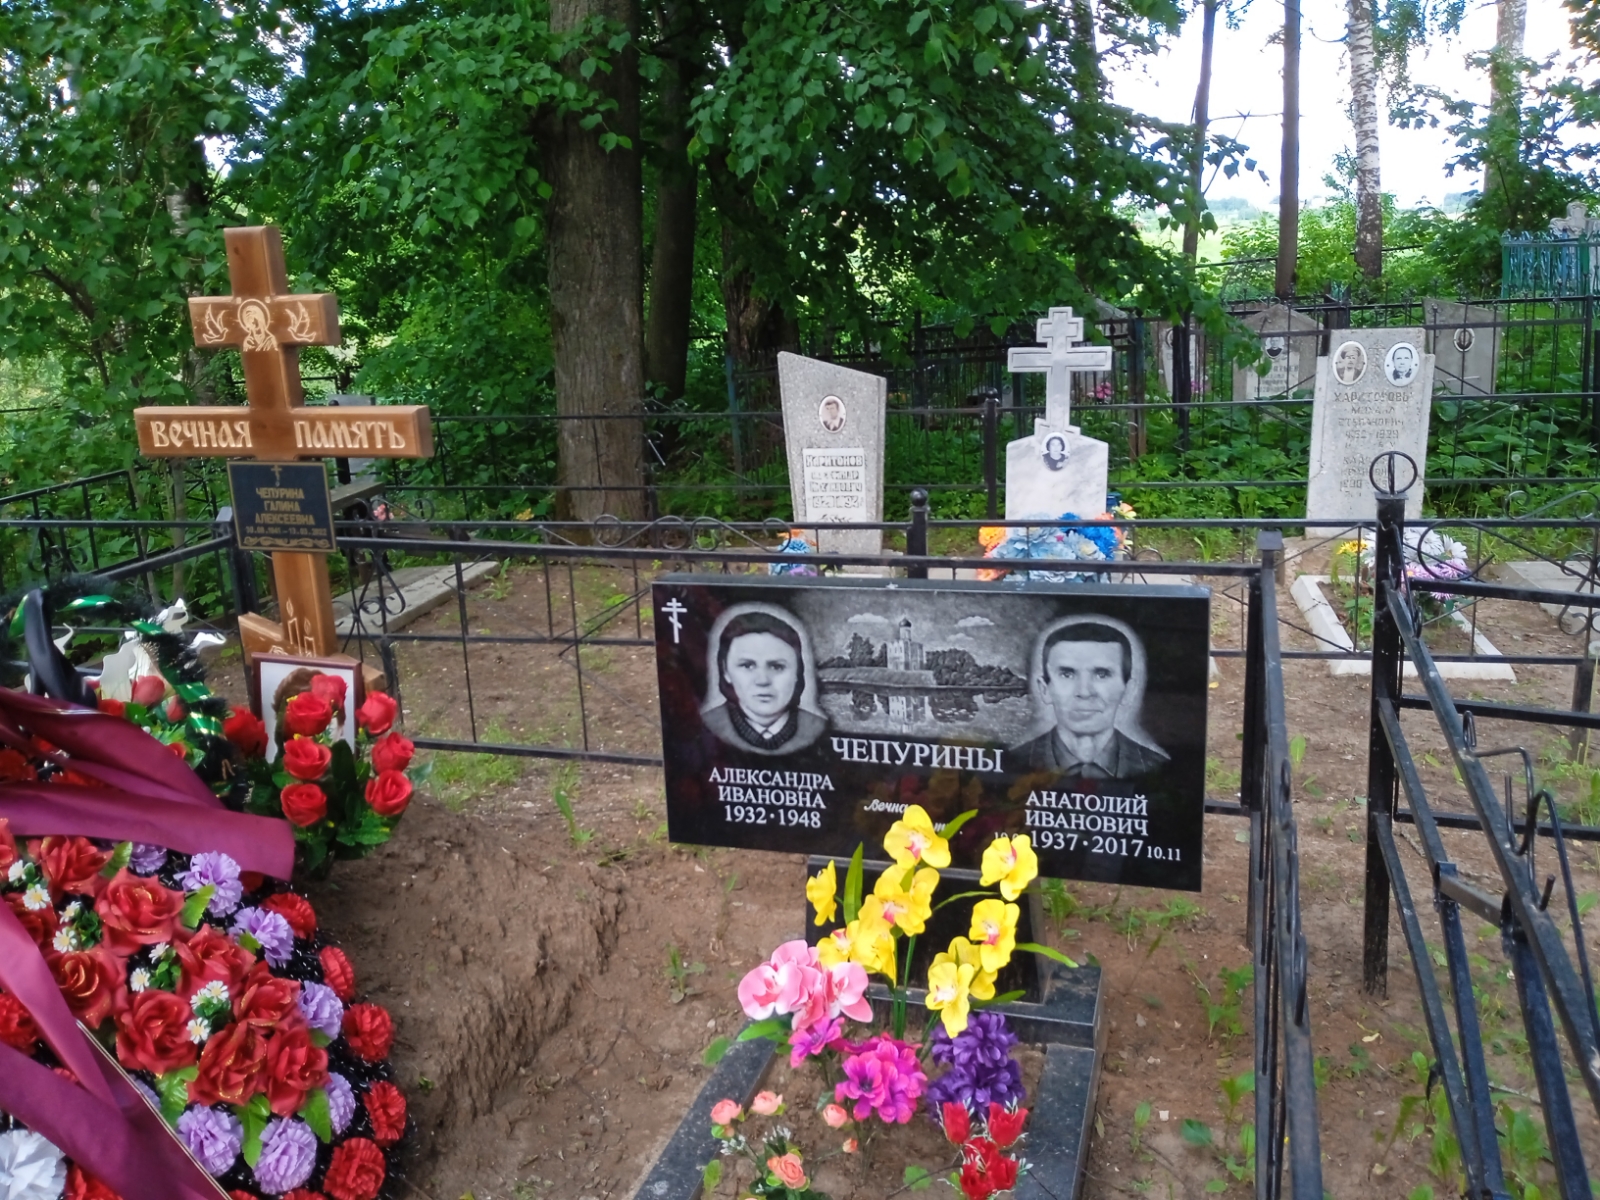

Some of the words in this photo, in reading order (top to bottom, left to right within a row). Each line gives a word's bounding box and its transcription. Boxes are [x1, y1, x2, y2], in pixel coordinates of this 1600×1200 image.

[293, 420, 406, 449] ПАМЯТЬ
[256, 487, 305, 499] ЧЕПУРИНА
[263, 500, 301, 512] ГАЛИНА
[255, 513, 316, 525] АЛЕКСЕЕВНА
[830, 737, 1003, 773] ЧЕПУРИНЫ
[709, 767, 835, 791] АЛЕКСАНДРА
[718, 785, 826, 809] ИВАНОВНА
[864, 799, 908, 814] Вечна
[1026, 790, 1149, 816] АНАТОЛИЙ
[1025, 809, 1149, 836] ИВАНОВИЧ
[1147, 846, 1182, 861] 10.11
